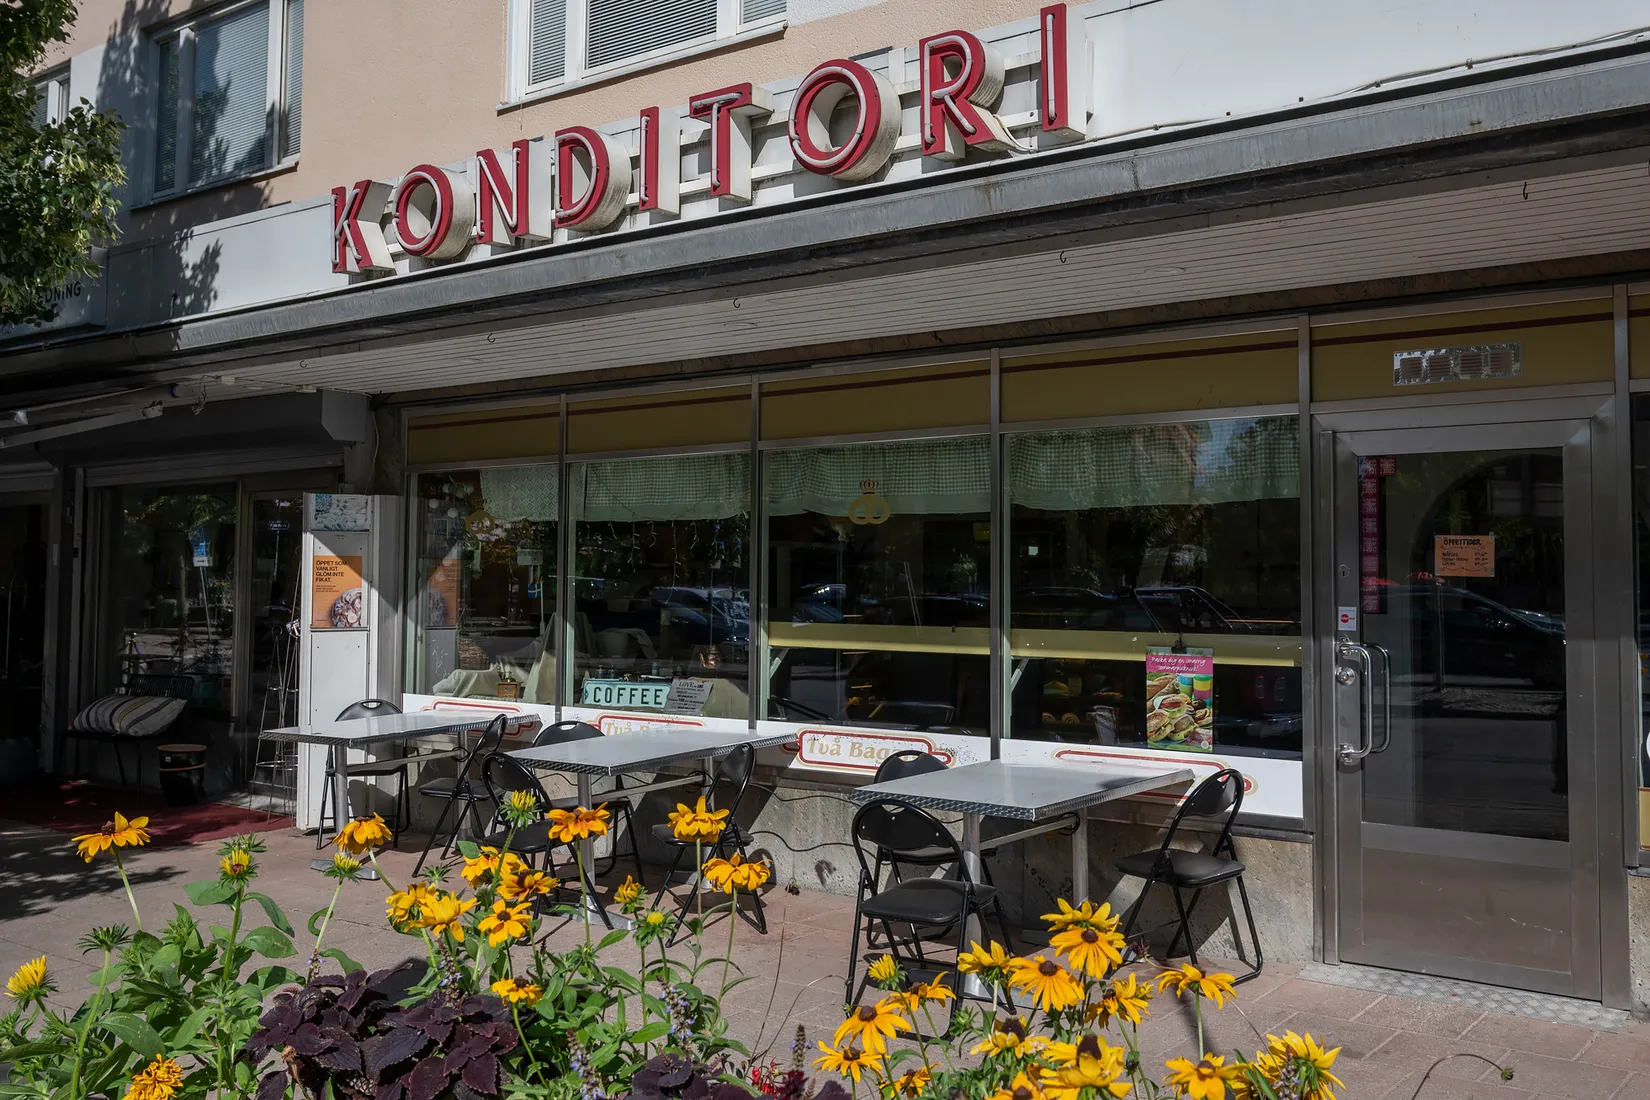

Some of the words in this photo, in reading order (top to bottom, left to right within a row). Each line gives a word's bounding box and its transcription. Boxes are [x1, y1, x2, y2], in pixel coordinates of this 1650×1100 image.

[331, 3, 1070, 274] KONDITORI
[1443, 537, 1481, 545] ÖPPETTIDER
[593, 686, 663, 705] COFFEE
